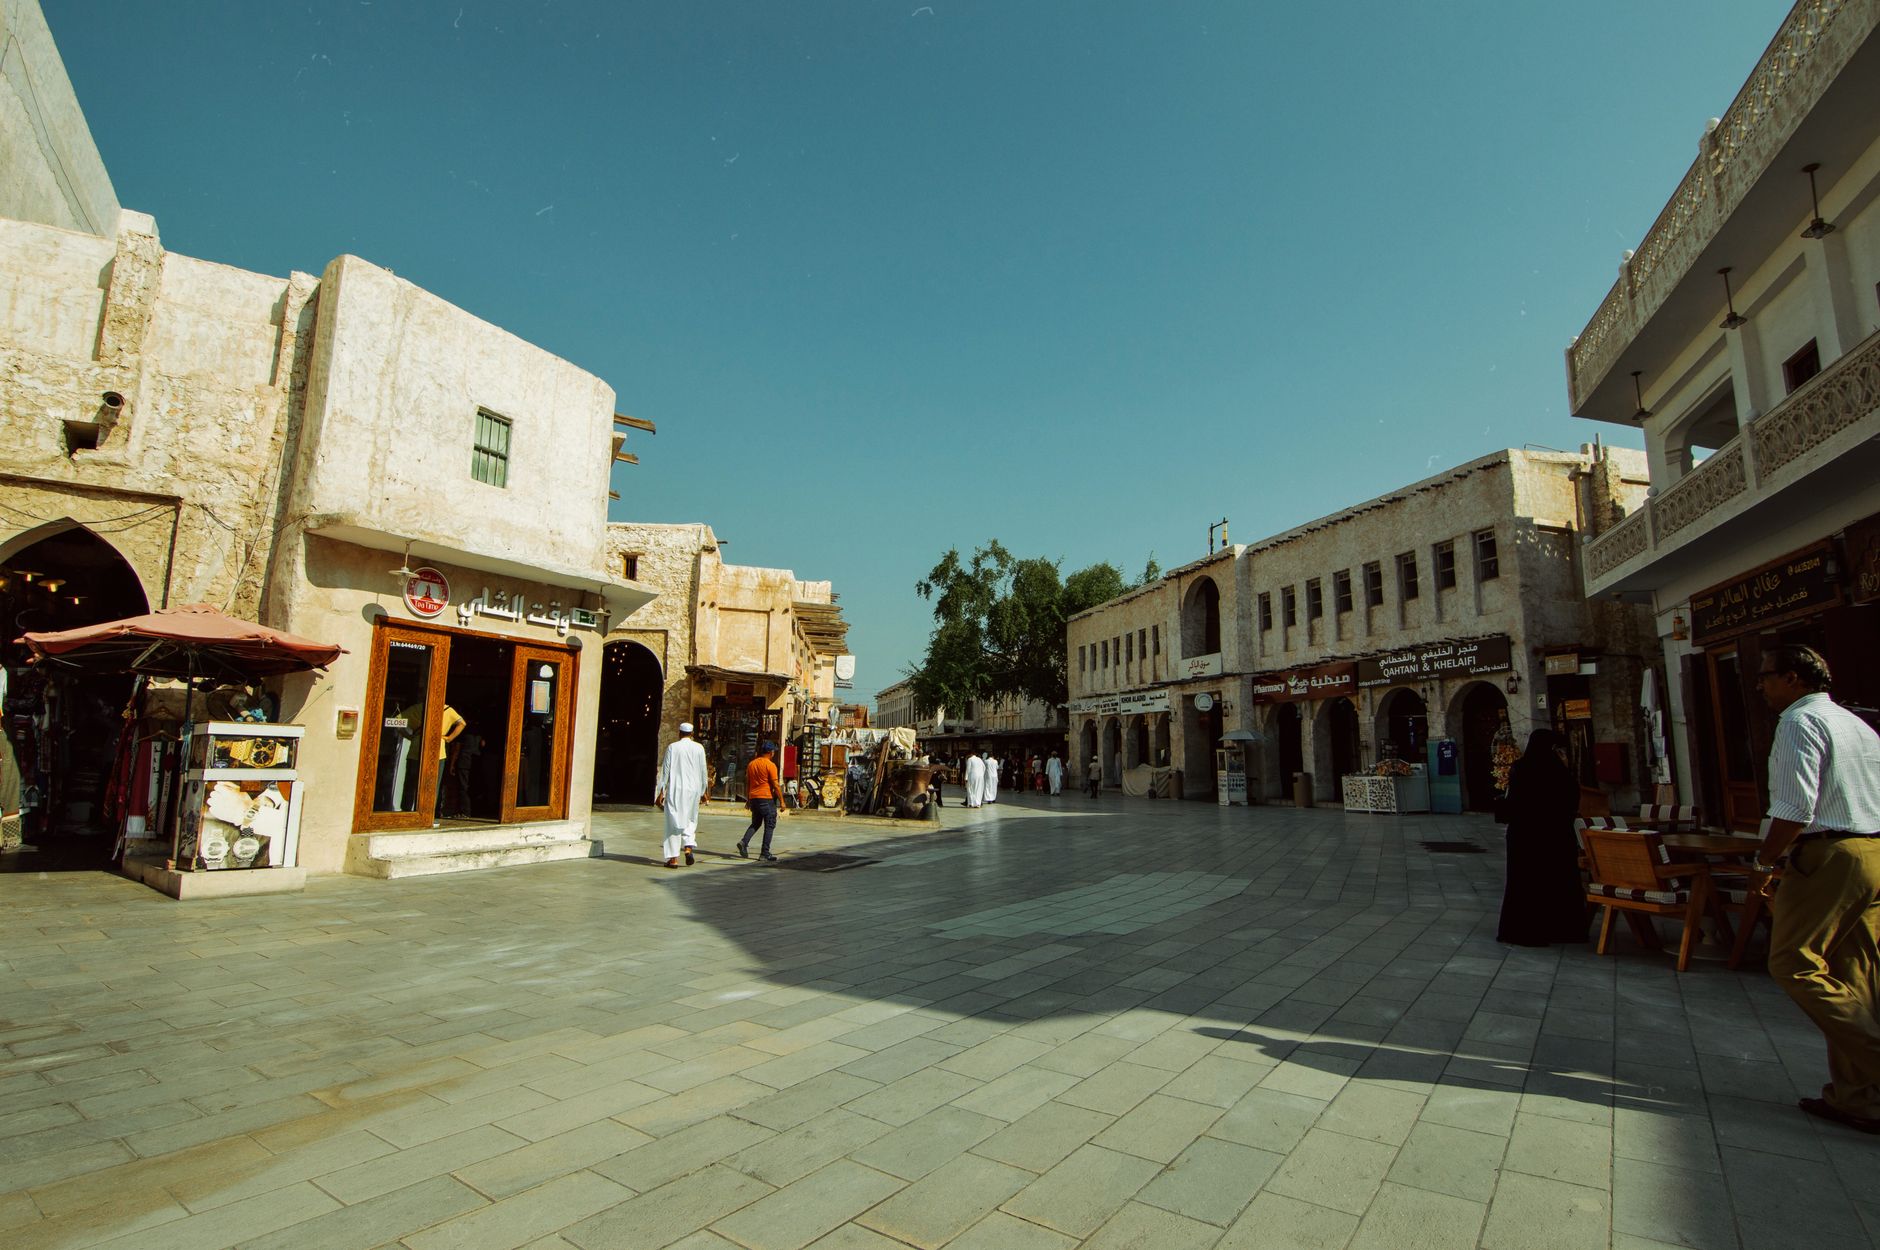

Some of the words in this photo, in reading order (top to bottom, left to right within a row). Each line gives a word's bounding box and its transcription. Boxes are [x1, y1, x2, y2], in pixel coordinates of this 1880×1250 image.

[414, 600, 425, 609] Tea
[425, 601, 439, 610] Time
[456, 586, 525, 626] الشاي
[527, 601, 570, 634] وقت
[1420, 645, 1454, 661] الخليفي
[1457, 644, 1478, 657] متجر
[1379, 652, 1416, 669] والقحطاني
[1383, 663, 1419, 678] QAHTANI
[1422, 662, 1431, 672] &
[1433, 656, 1476, 671] KHELAIFI
[1491, 662, 1509, 670] للتحف
[1469, 664, 1491, 674] والهدايا
[1253, 683, 1285, 694] Pharmacy
[386, 719, 406, 727] CLOSE
